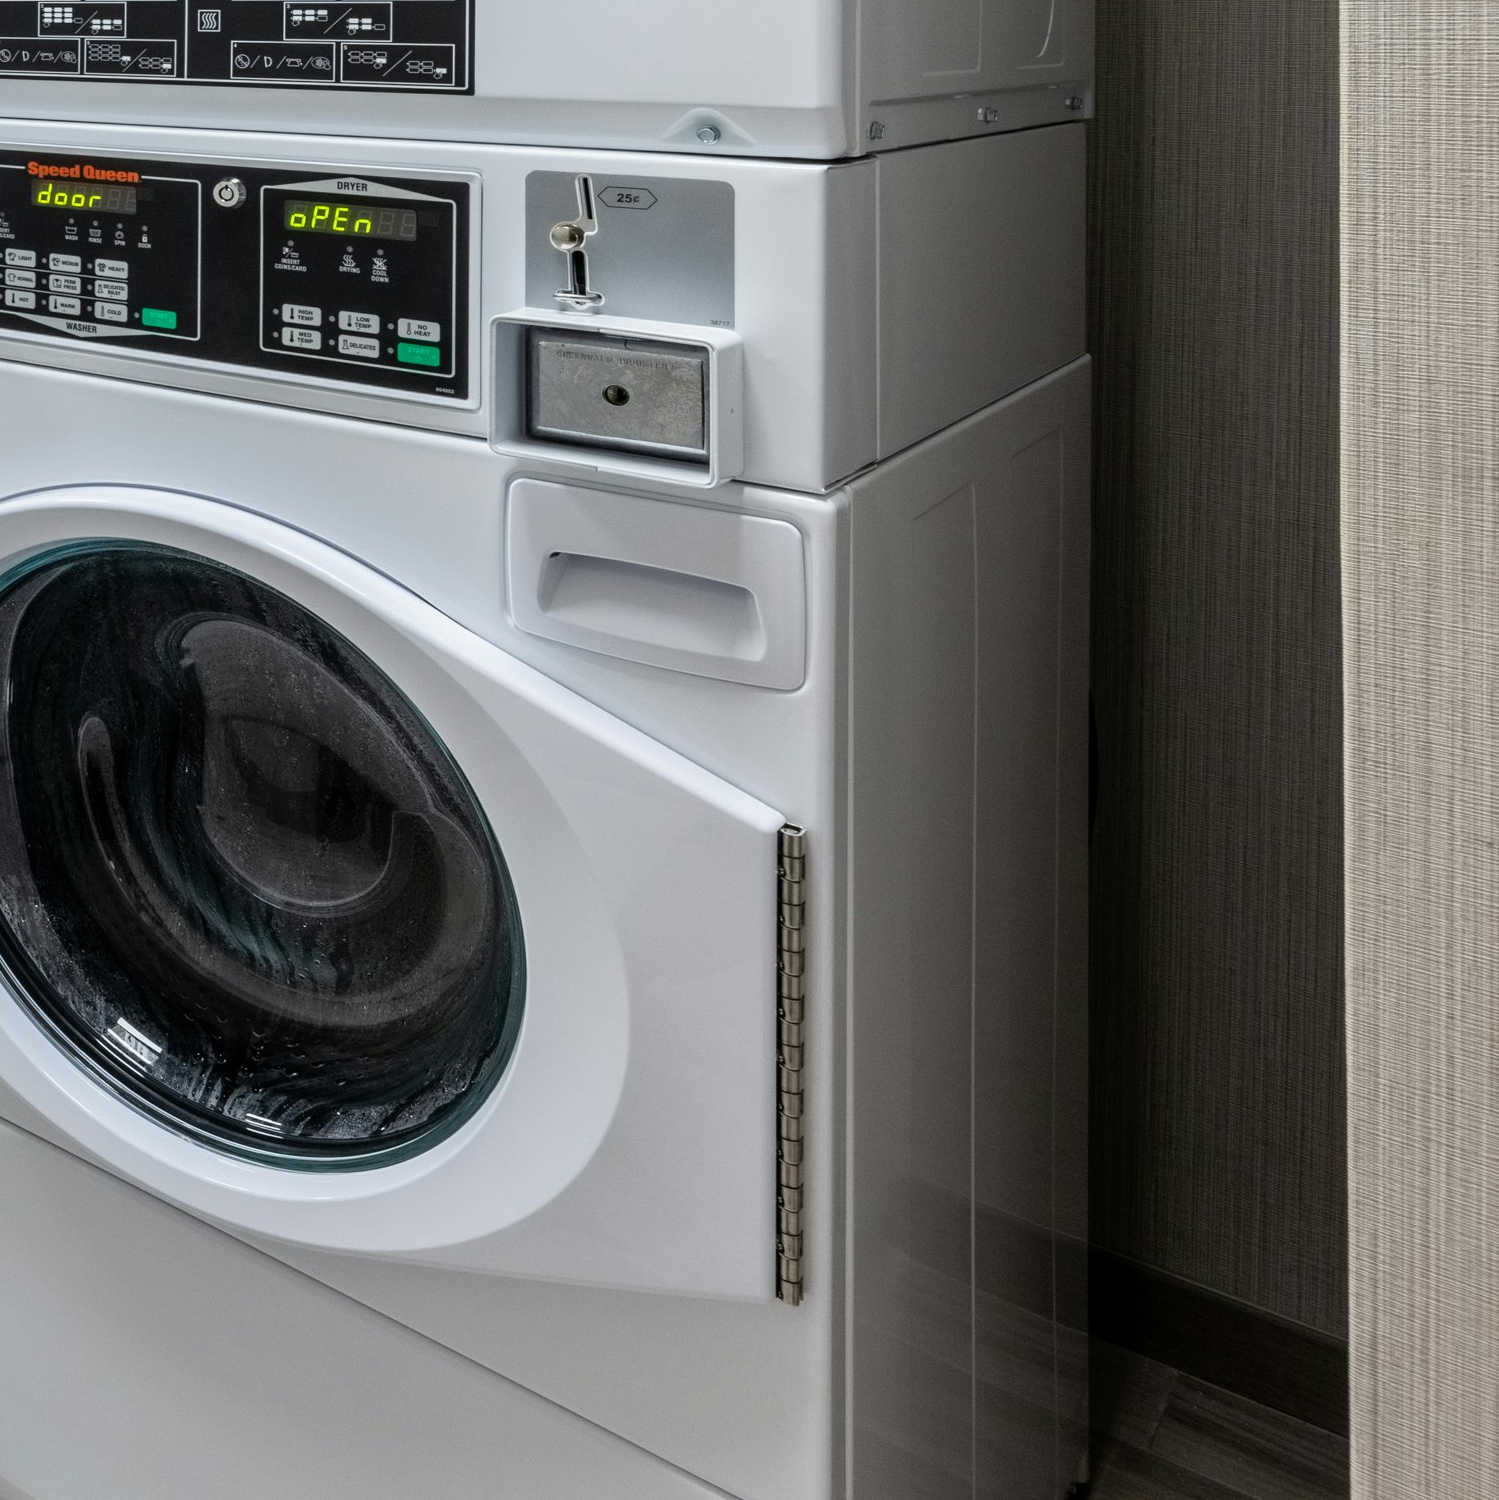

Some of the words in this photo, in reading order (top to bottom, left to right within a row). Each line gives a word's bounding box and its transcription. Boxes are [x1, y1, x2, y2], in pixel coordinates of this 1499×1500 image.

[27, 161, 80, 178] Speed
[83, 165, 139, 183] Queen
[337, 181, 368, 192] DRYER
[37, 183, 101, 208] door
[617, 193, 640, 204] 25¢
[281, 258, 300, 266] INSERT
[275, 263, 307, 272] COINS/CARD
[339, 266, 360, 274] DRYING
[372, 269, 388, 277] COOL
[371, 276, 389, 284] DOWN
[66, 322, 98, 334] WASHER
[349, 342, 376, 351] DELICATES
